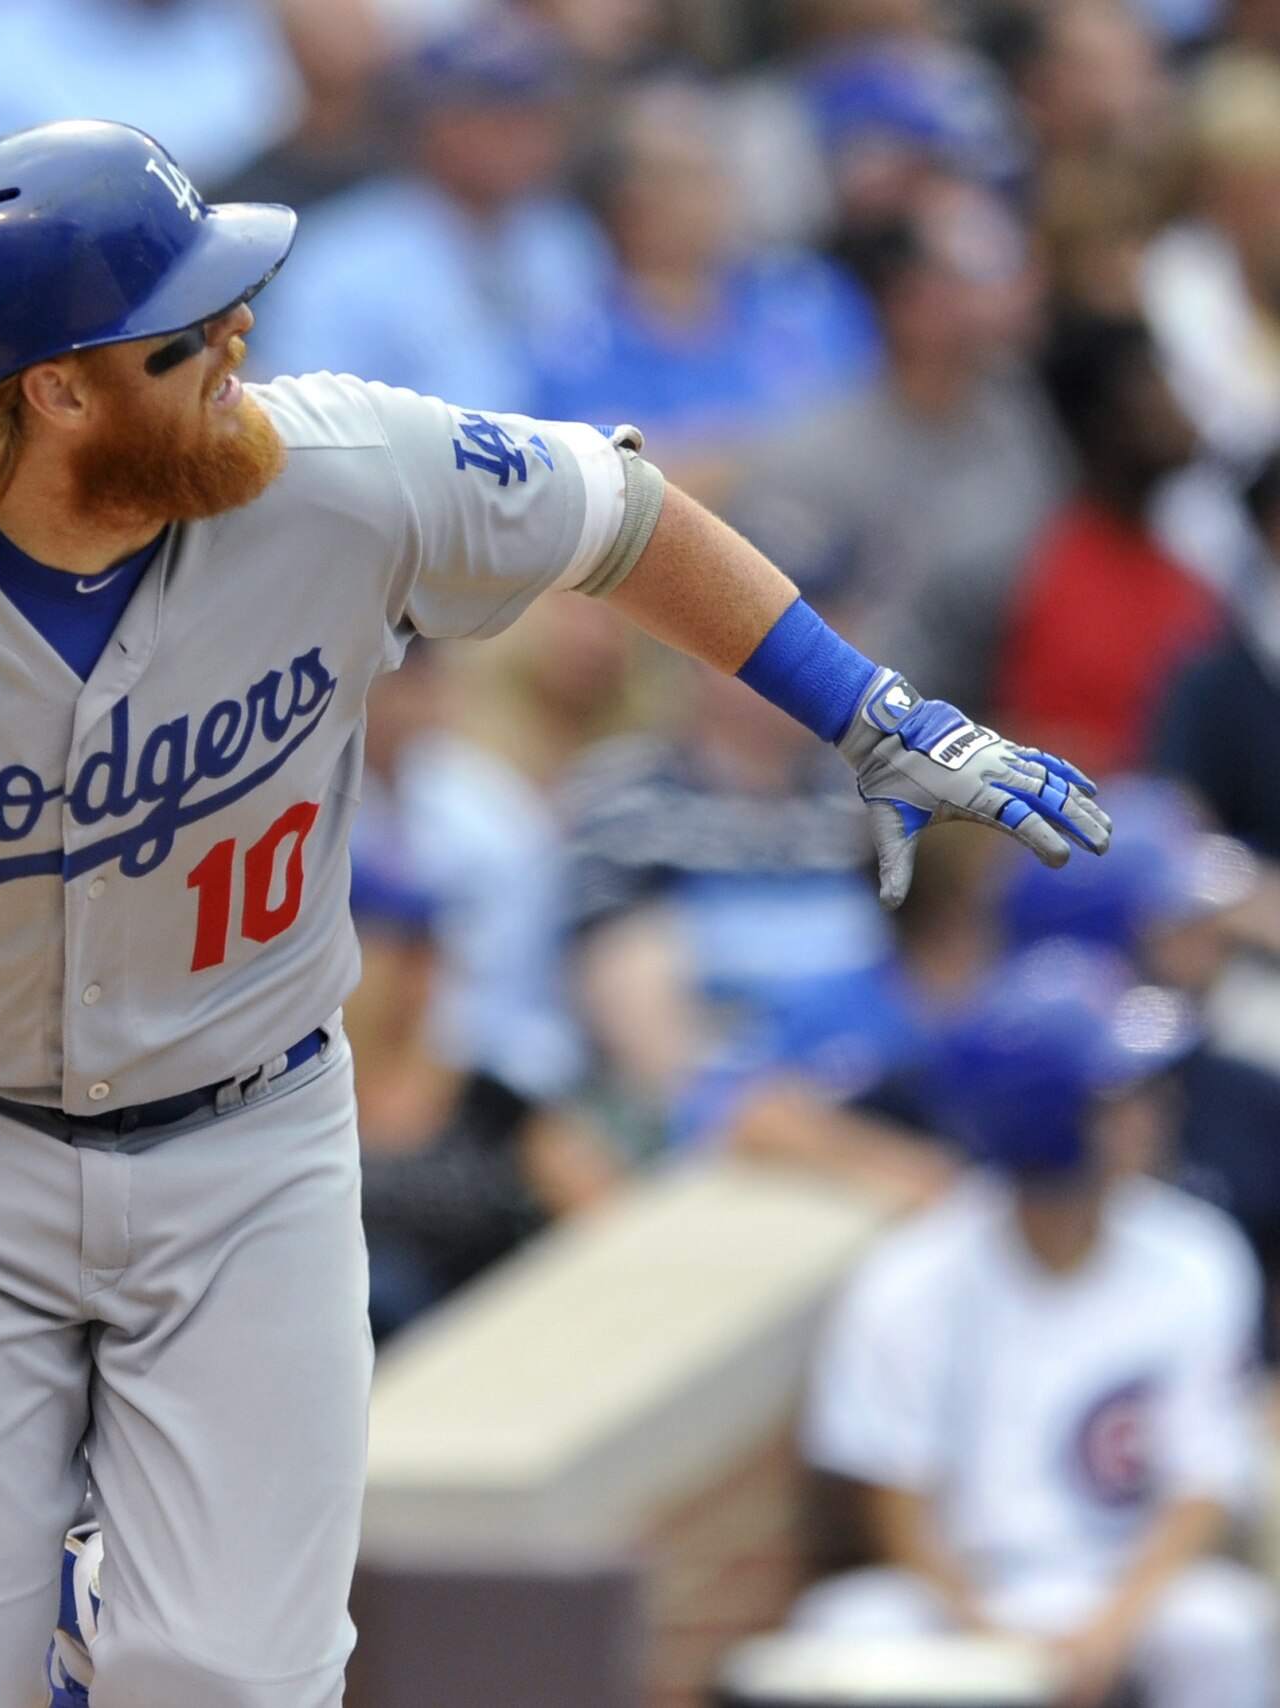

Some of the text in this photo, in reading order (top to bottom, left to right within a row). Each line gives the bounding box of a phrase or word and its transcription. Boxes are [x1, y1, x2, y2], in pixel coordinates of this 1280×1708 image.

[452, 412, 527, 487] LA
[938, 725, 993, 763] Franklin
[187, 801, 320, 972] 10
